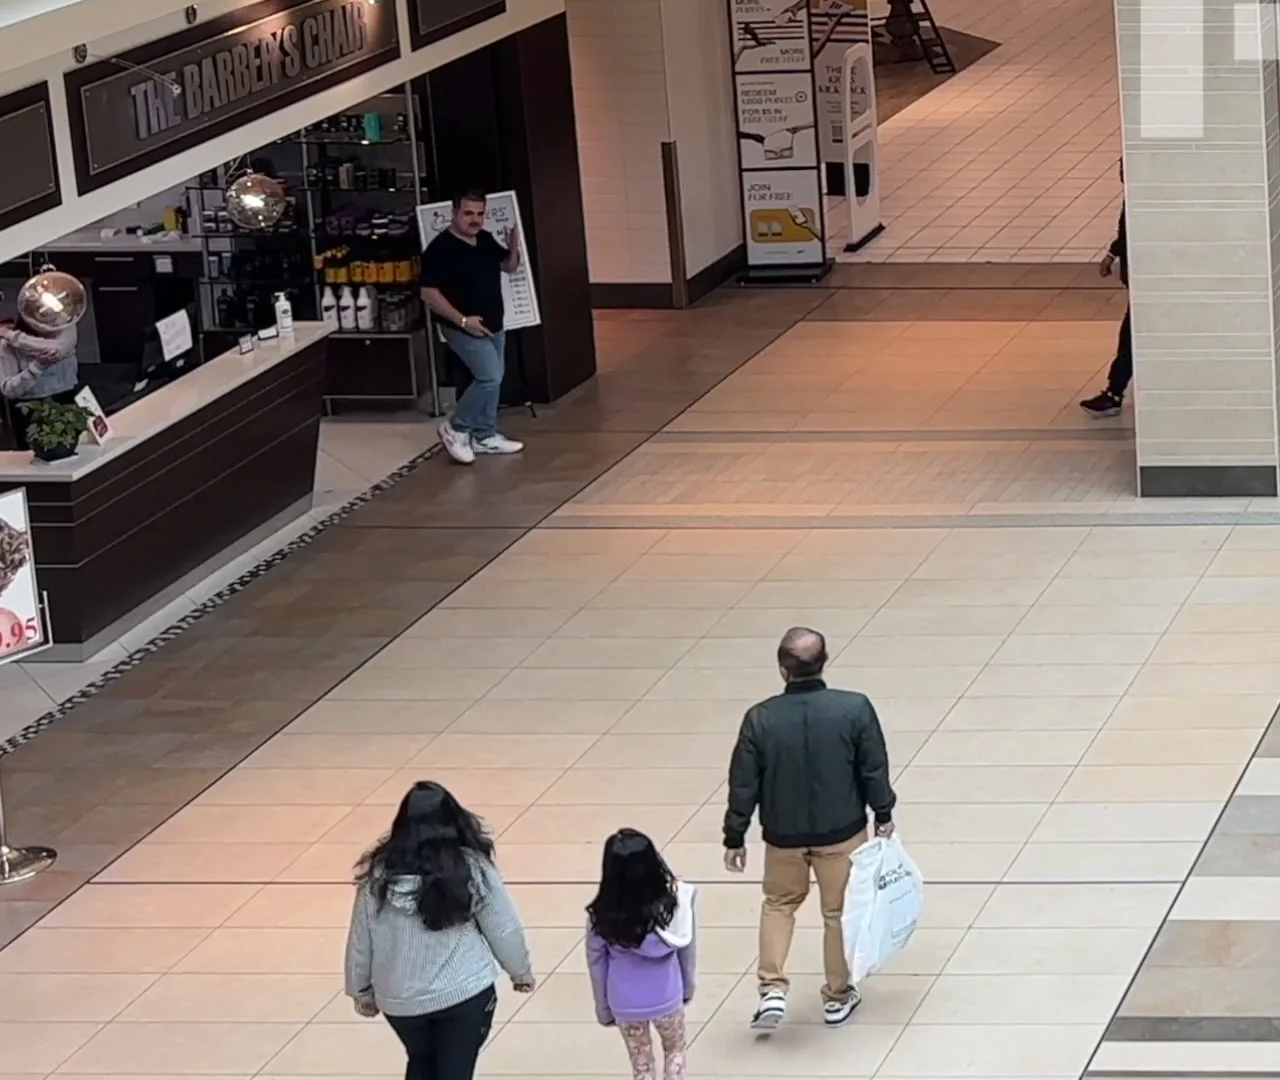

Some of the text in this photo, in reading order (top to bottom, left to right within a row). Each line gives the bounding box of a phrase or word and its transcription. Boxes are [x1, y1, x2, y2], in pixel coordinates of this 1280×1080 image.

[128, 1, 368, 141] THE BARBER'S CHAIR
[747, 183, 771, 193] JOIN
